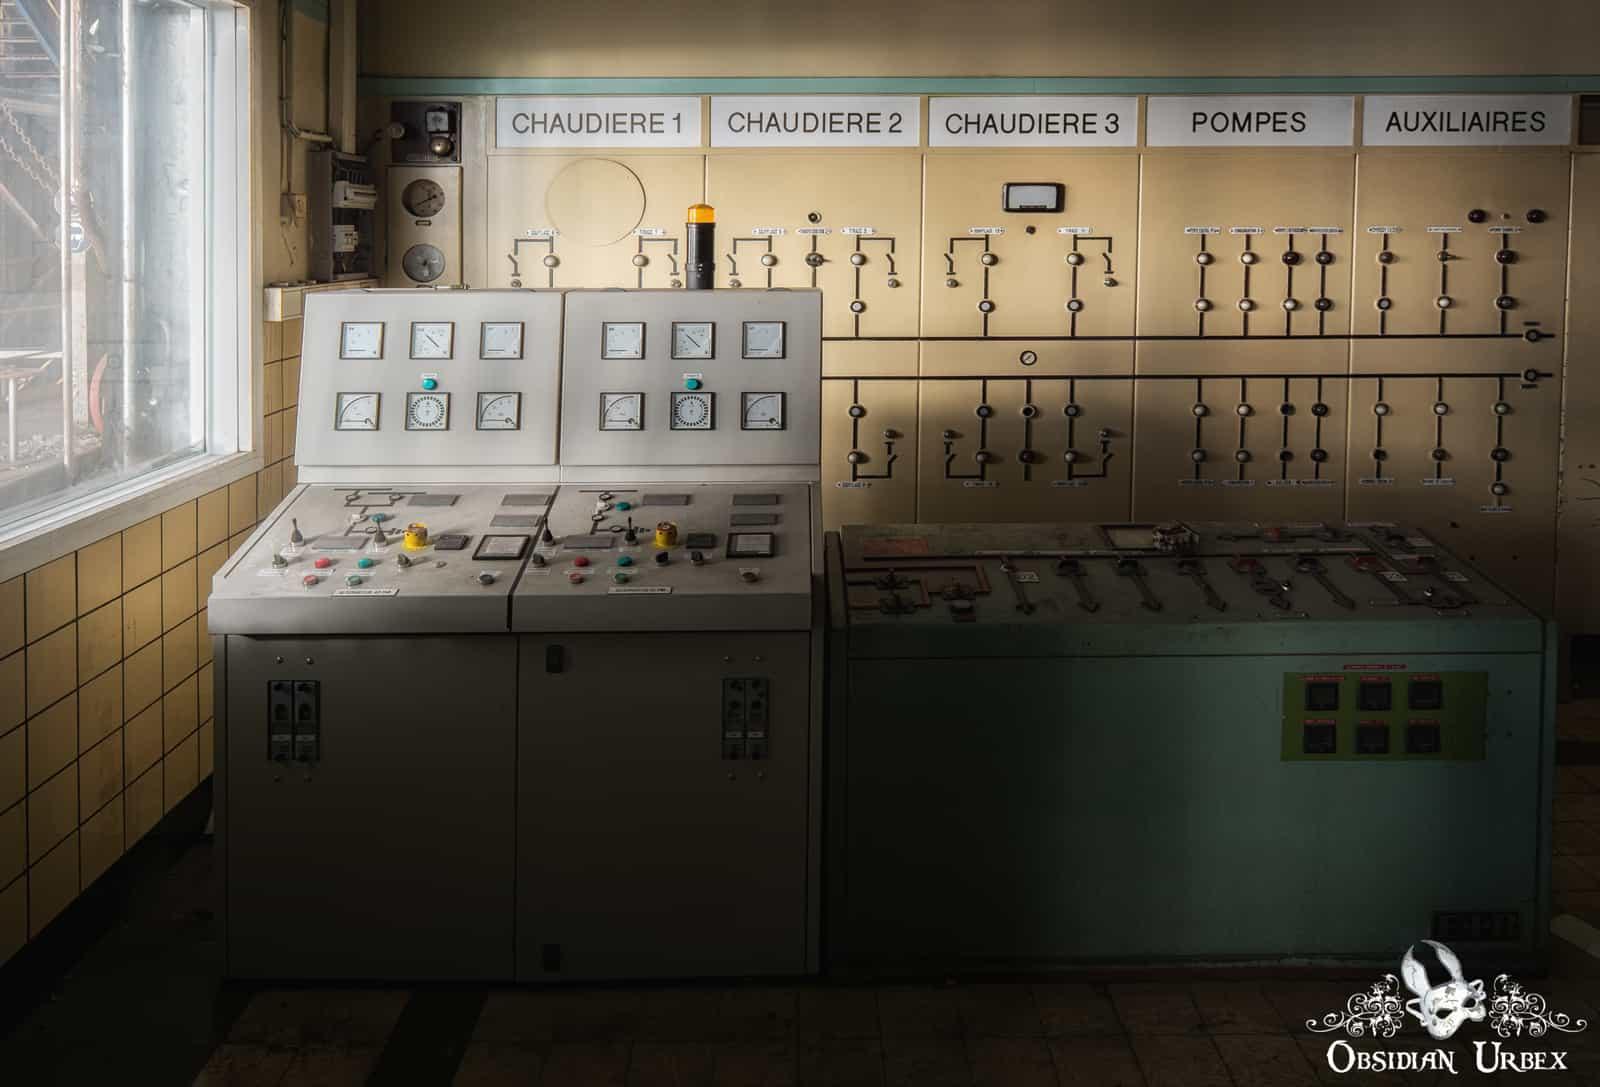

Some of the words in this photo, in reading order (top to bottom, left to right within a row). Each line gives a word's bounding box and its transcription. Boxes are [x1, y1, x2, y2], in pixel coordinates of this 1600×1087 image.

[511, 112, 665, 135] CHAUDIERE
[672, 112, 682, 134] 1
[727, 111, 882, 134] CHAUDIERE
[888, 111, 903, 134] 2
[945, 112, 1098, 135] CHAUDIERE
[1104, 112, 1120, 135] 3
[1192, 111, 1307, 134] POMPES
[1385, 111, 1546, 132] AUXILIAIRES
